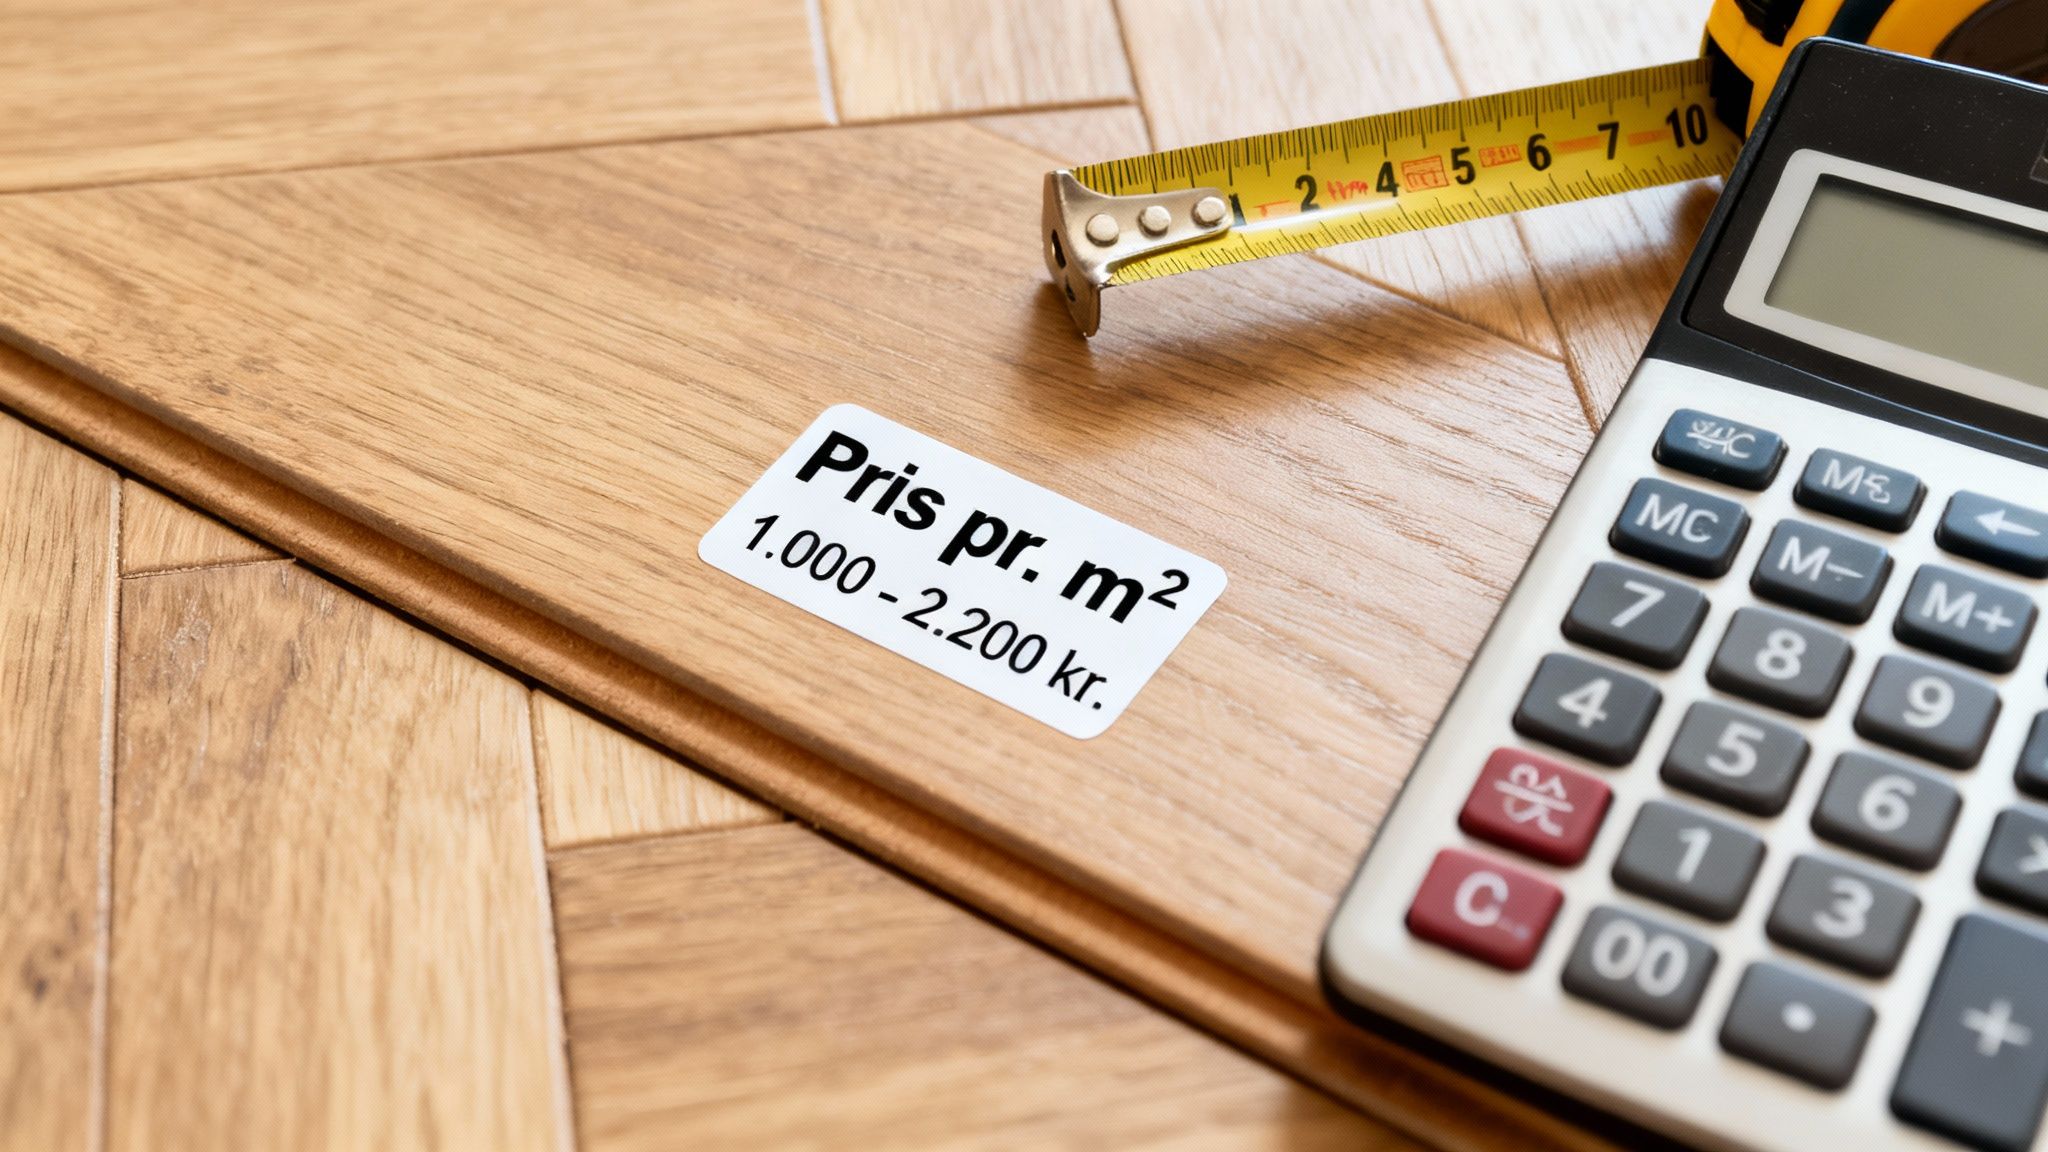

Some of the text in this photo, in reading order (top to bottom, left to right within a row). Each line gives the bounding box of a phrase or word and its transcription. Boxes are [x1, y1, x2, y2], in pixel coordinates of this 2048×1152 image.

[1294, 174, 1321, 212] 2
[1375, 160, 1399, 198] 4
[1450, 146, 1476, 186] 5
[1526, 132, 1553, 172] 6
[1596, 120, 1620, 161] 7
[1664, 103, 1709, 149] 10
[794, 430, 946, 531] Pris
[936, 509, 1048, 583] pr.
[1635, 493, 1719, 543] MC
[745, 513, 1108, 711] 1.000 - 2.200 kr.
[1610, 580, 1667, 628] 7
[1920, 581, 2015, 633] M+
[1754, 627, 1808, 680] 8
[1557, 677, 1612, 729] 4
[1902, 676, 1955, 729] 9
[1705, 720, 1766, 777] 5
[1858, 775, 1916, 832] 6
[1676, 826, 1713, 882] 1
[1453, 869, 1510, 928] C
[1813, 877, 1874, 939] 3
[1590, 922, 1689, 998] 00
